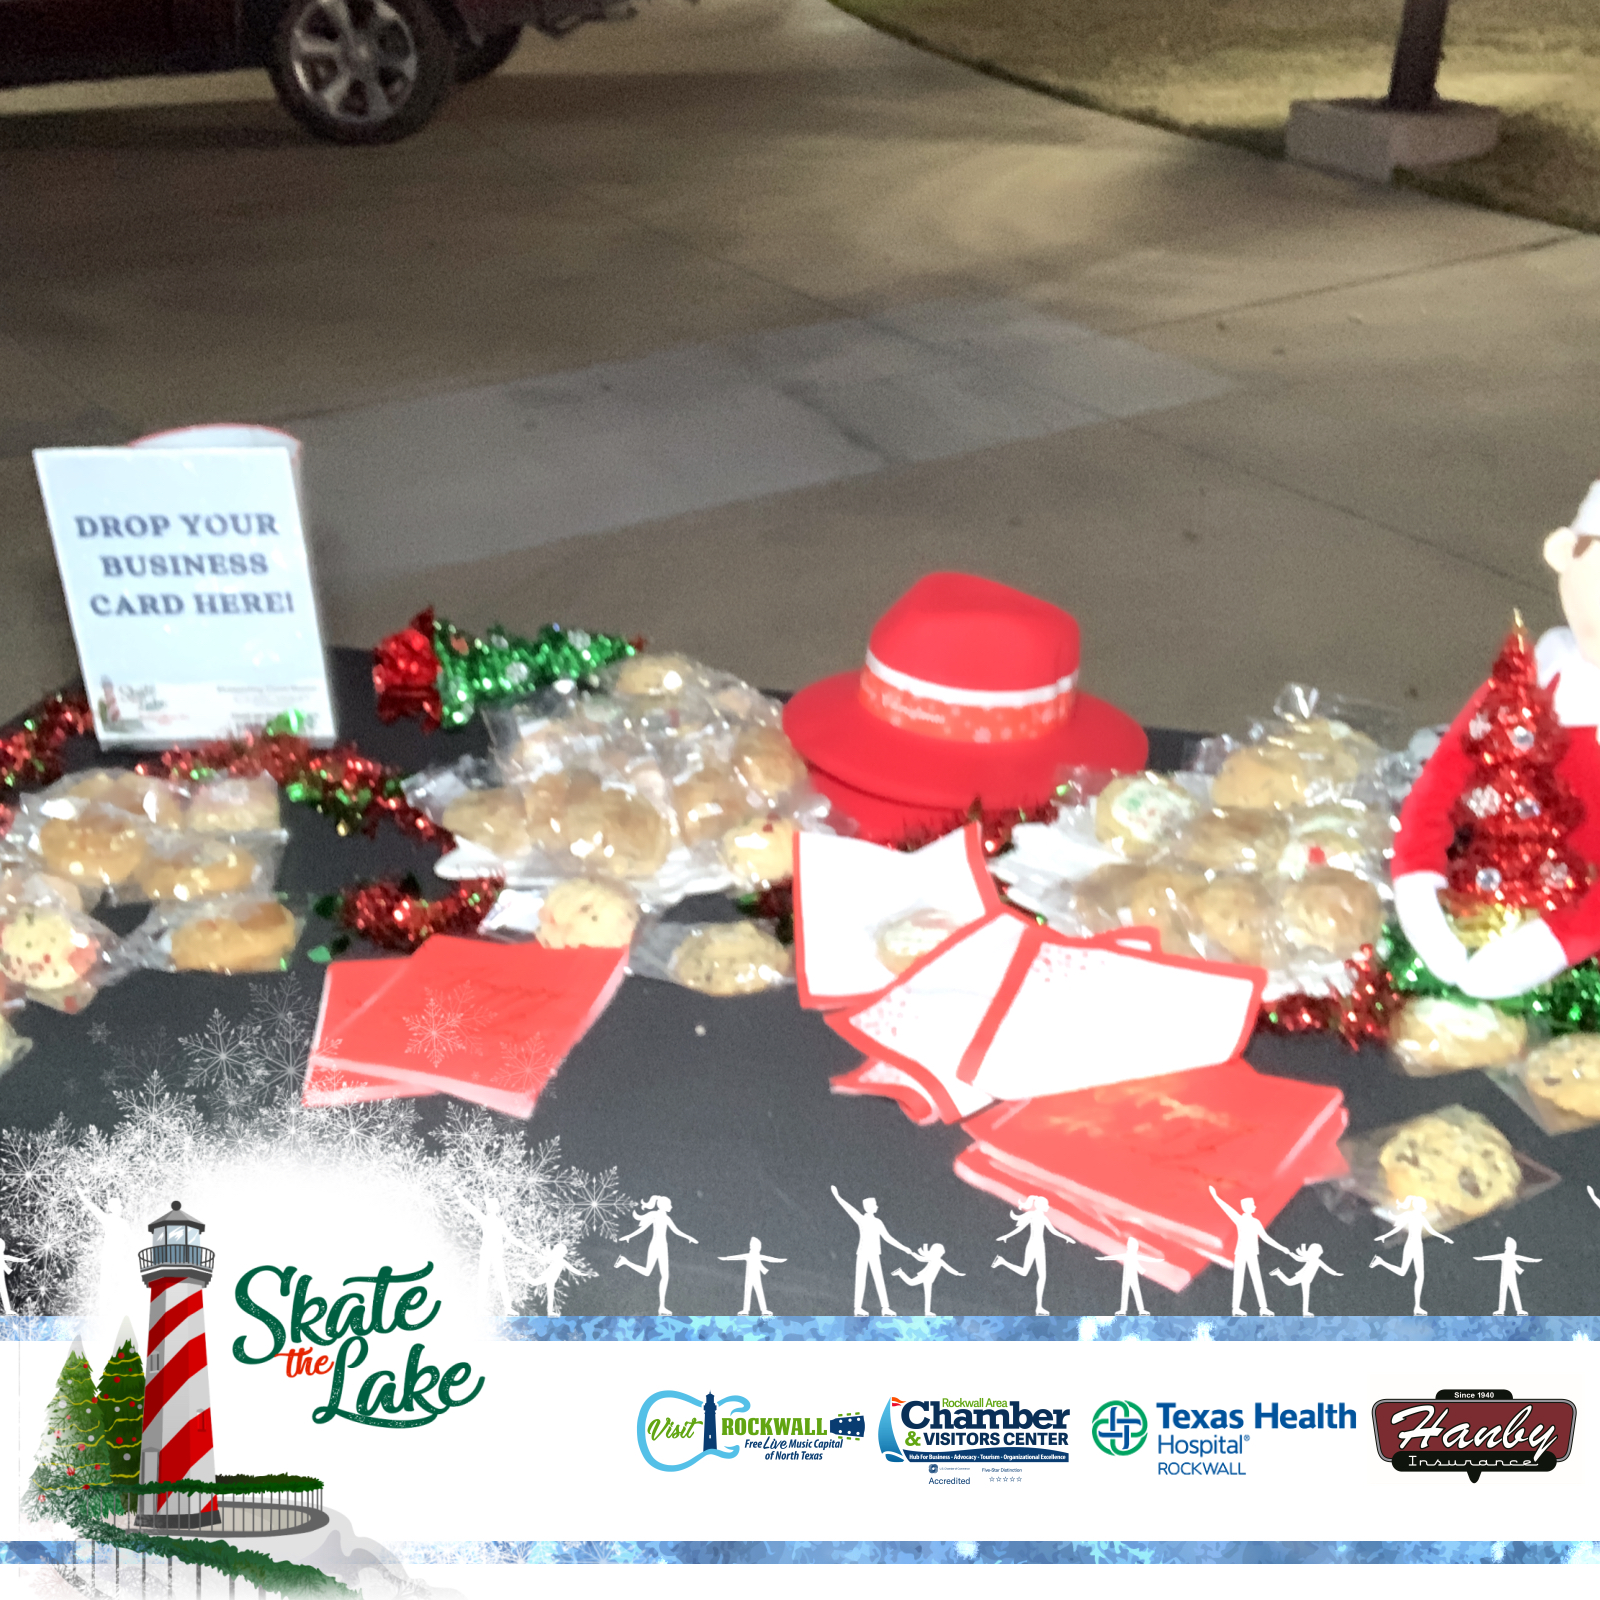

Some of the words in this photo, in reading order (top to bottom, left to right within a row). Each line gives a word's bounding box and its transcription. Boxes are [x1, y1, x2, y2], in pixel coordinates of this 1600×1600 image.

[75, 514, 170, 538] DROP
[179, 513, 279, 537] YOUR
[100, 553, 269, 577] BUSINESS
[90, 593, 184, 616] CARD
